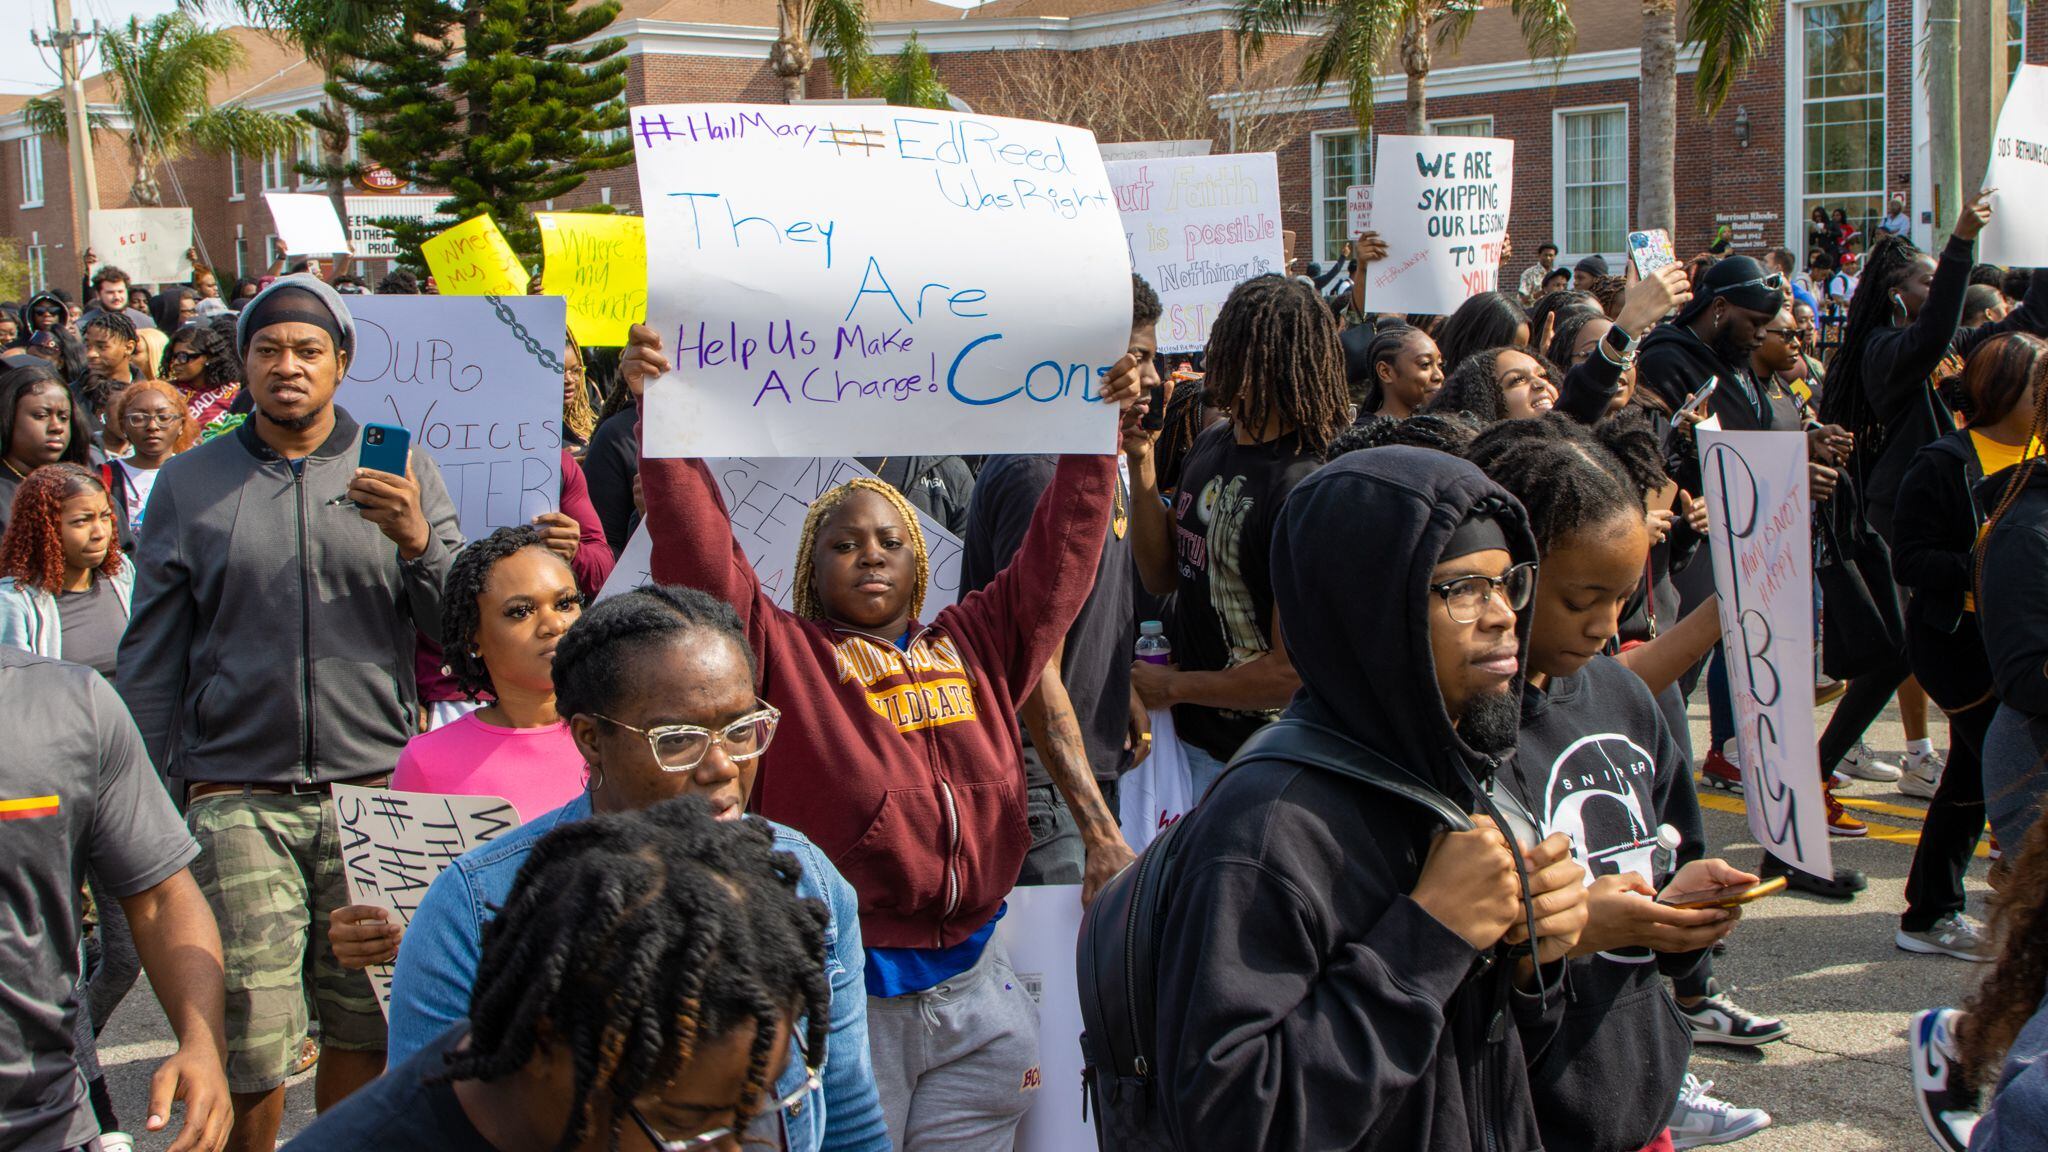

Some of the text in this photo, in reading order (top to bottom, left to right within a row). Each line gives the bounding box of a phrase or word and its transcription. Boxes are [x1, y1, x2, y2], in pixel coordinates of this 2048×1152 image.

[1416, 151, 1493, 179] WE ARE
[1349, 201, 1374, 211] PARKIN
[1357, 190, 1370, 200] NO
[1417, 183, 1498, 211] SKIPPING
[666, 192, 835, 268] They
[1184, 213, 1275, 261] possible
[1427, 216, 1465, 237] OUR
[559, 229, 624, 266] Where
[1449, 245, 1475, 267] TO
[845, 256, 989, 324] Are
[346, 317, 483, 393] OUR
[676, 319, 914, 370] Help Us Make
[384, 394, 561, 450] VOICES
[1562, 761, 1647, 790] SNIPER
[339, 796, 381, 897] SAVE
